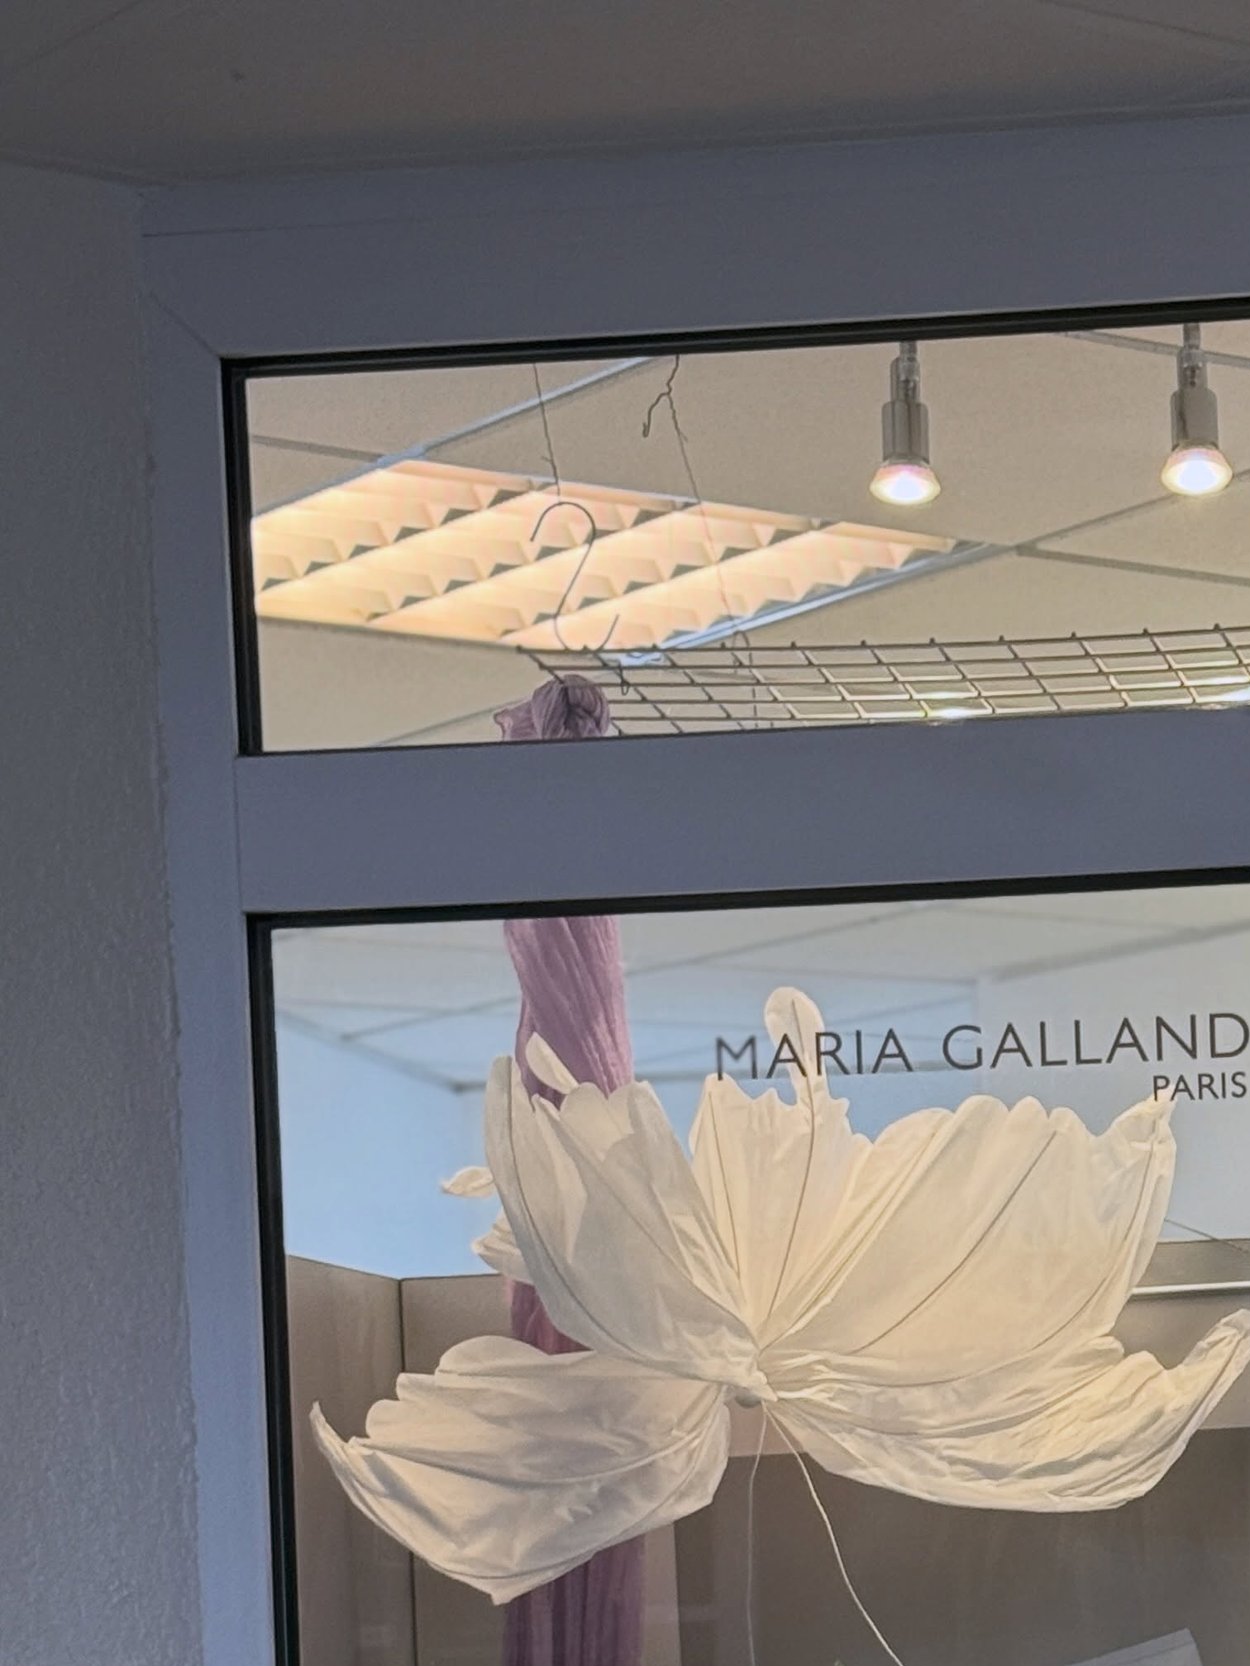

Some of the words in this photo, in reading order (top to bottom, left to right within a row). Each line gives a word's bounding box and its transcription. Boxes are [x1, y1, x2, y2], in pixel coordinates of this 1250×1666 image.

[714, 1028, 914, 1081] MARIA
[942, 1012, 1250, 1070] GALLAND
[1153, 1072, 1247, 1103] PARIS
